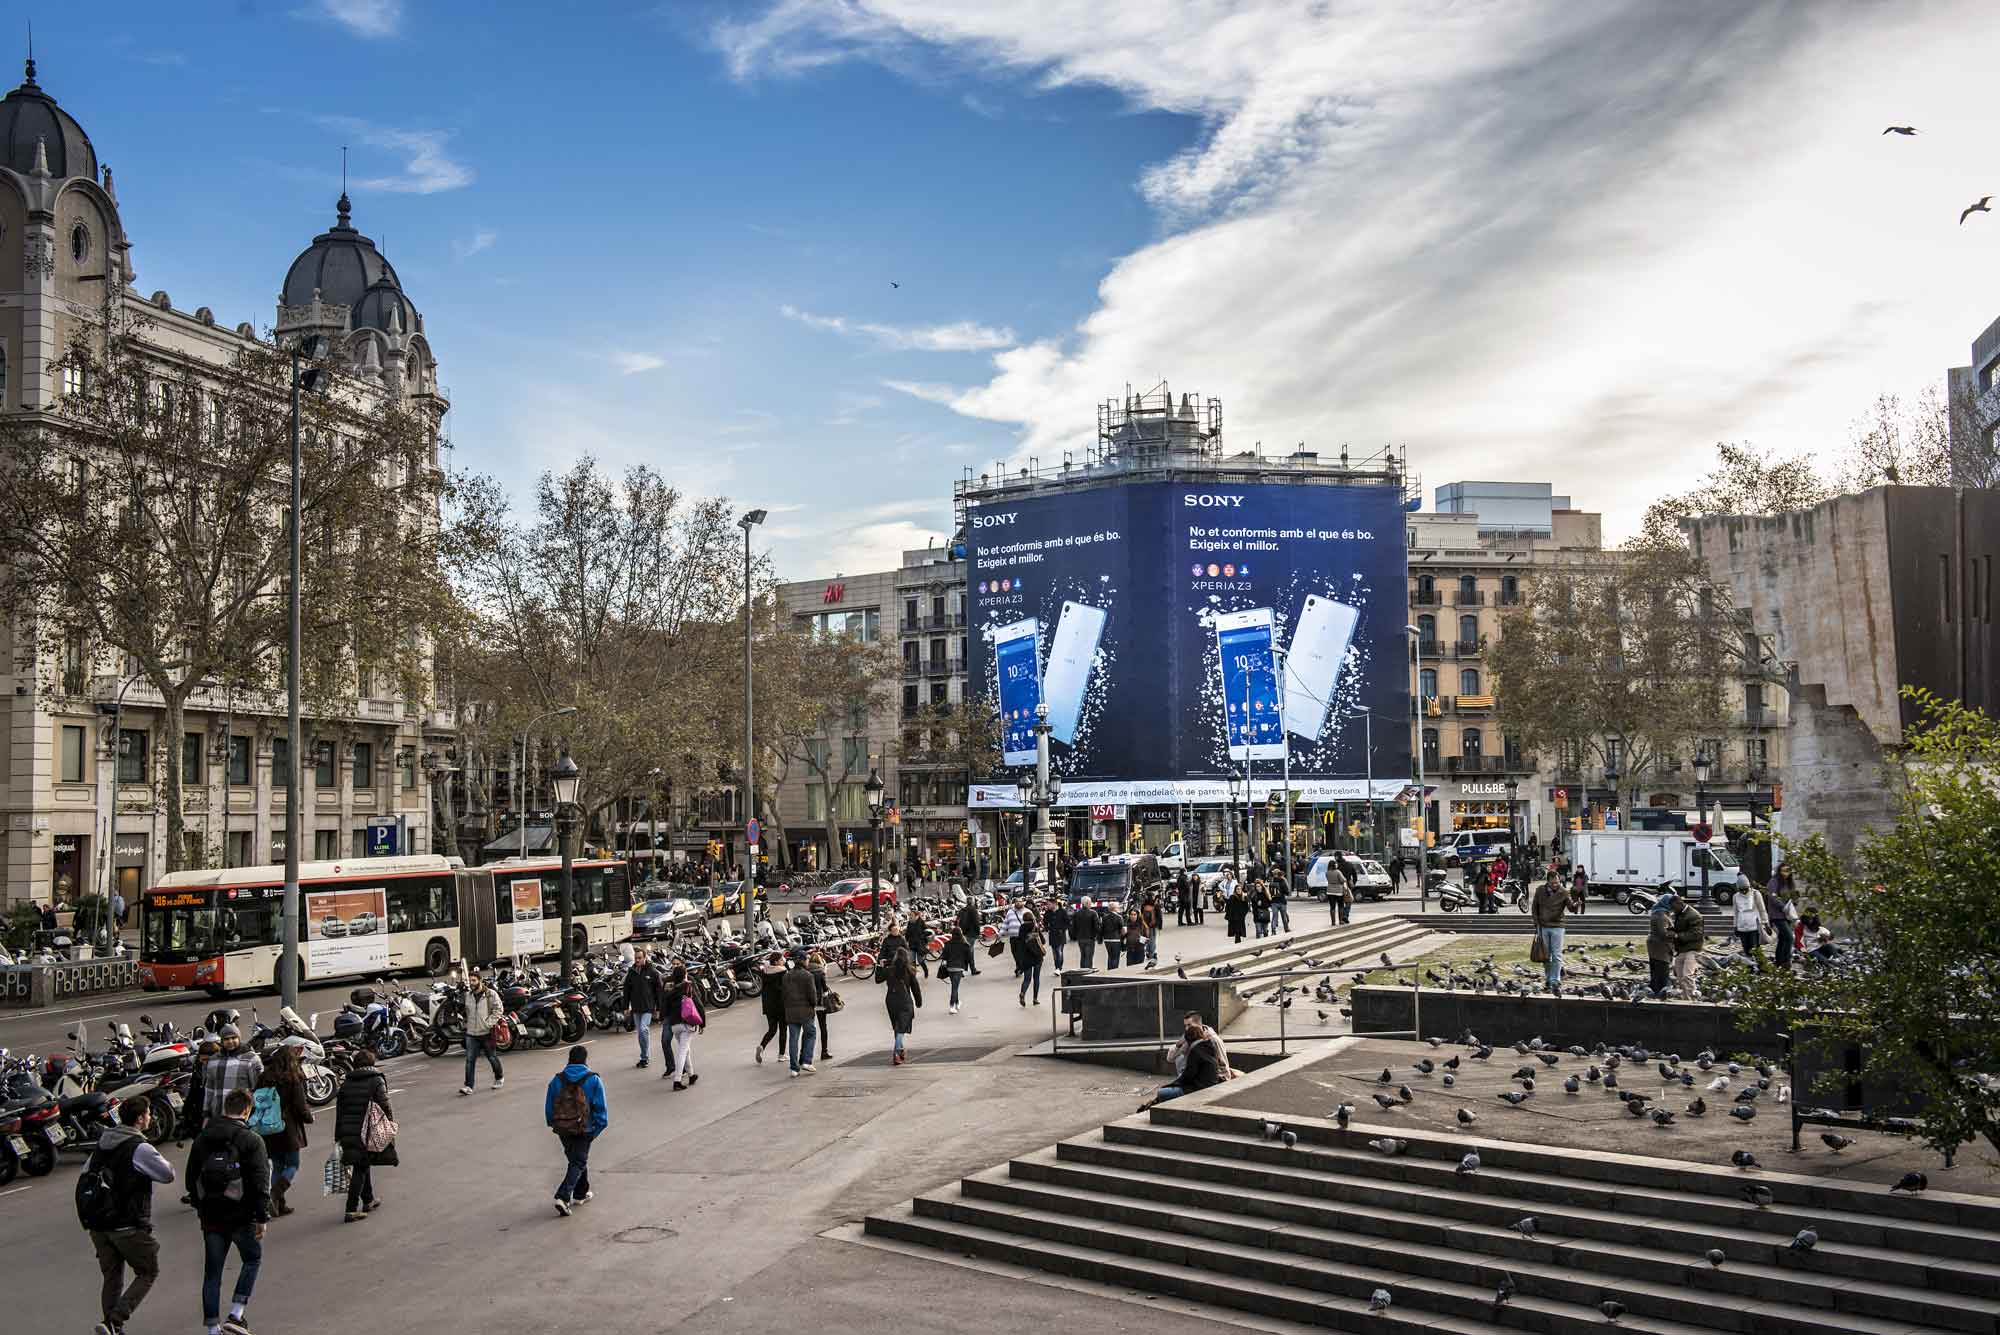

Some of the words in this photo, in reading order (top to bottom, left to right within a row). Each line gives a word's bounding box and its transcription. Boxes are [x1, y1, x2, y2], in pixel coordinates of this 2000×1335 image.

[1184, 494, 1245, 507] SONY
[973, 512, 1018, 529] SONY
[1189, 526, 1206, 537] No
[1208, 527, 1219, 537] et
[1222, 526, 1277, 538] conformis
[1279, 528, 1304, 538] amb
[1306, 528, 1316, 539] el
[1318, 530, 1339, 541] que
[1341, 528, 1354, 539] és
[1357, 529, 1374, 540] bo.
[977, 546, 989, 556] No
[990, 545, 999, 555] et
[1000, 539, 1043, 554] conformis
[1044, 537, 1064, 548] amb
[1065, 536, 1073, 546] el
[1074, 534, 1092, 546] que
[1093, 531, 1104, 543] és
[1106, 530, 1121, 540] bo.
[1189, 539, 1230, 551] Exigeix
[1232, 540, 1243, 550] el
[1245, 540, 1279, 551] millor.
[977, 556, 1007, 569] Exigeix
[1008, 555, 1017, 565] el
[1018, 552, 1044, 563] millor.
[1191, 581, 1236, 591] XPERIA
[1237, 581, 1252, 591] Z3
[978, 595, 1011, 607] XPERIA
[1011, 594, 1023, 604] Z3
[1119, 789, 1128, 797] de
[1307, 787, 1318, 795] de
[1319, 787, 1361, 795] Barcelona
[1461, 783, 1520, 794] PULL&BE
[377, 826, 388, 844] P
